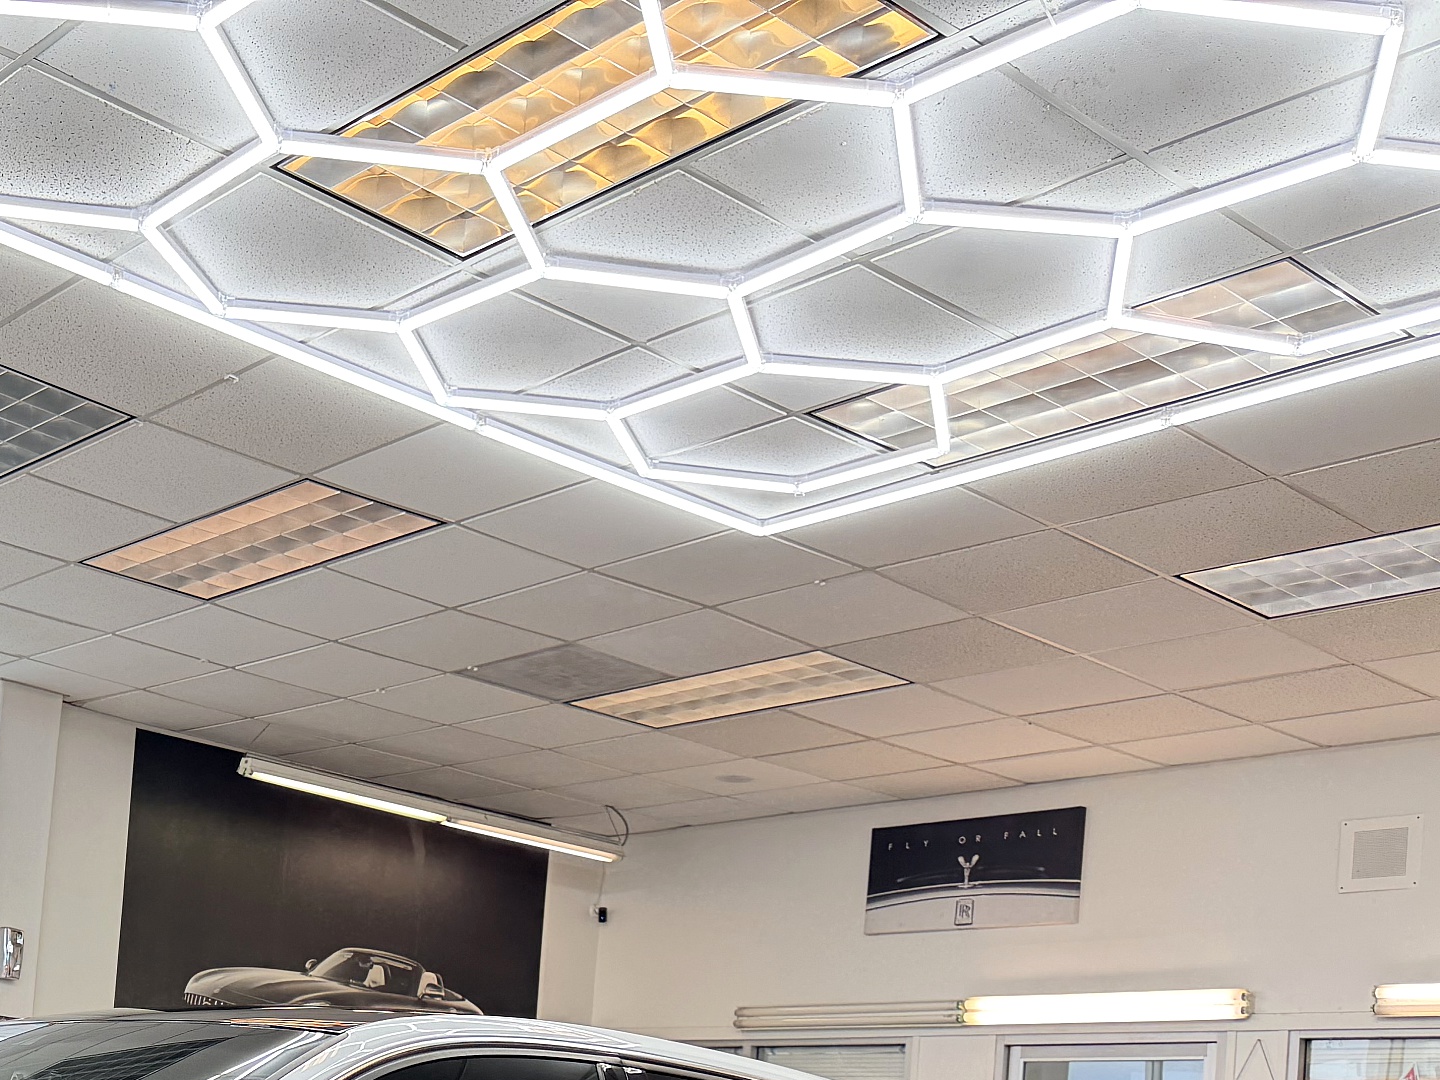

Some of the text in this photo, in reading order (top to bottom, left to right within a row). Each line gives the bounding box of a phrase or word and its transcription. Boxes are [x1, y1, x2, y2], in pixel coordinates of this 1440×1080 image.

[887, 827, 1058, 851] FLY OR FALL
